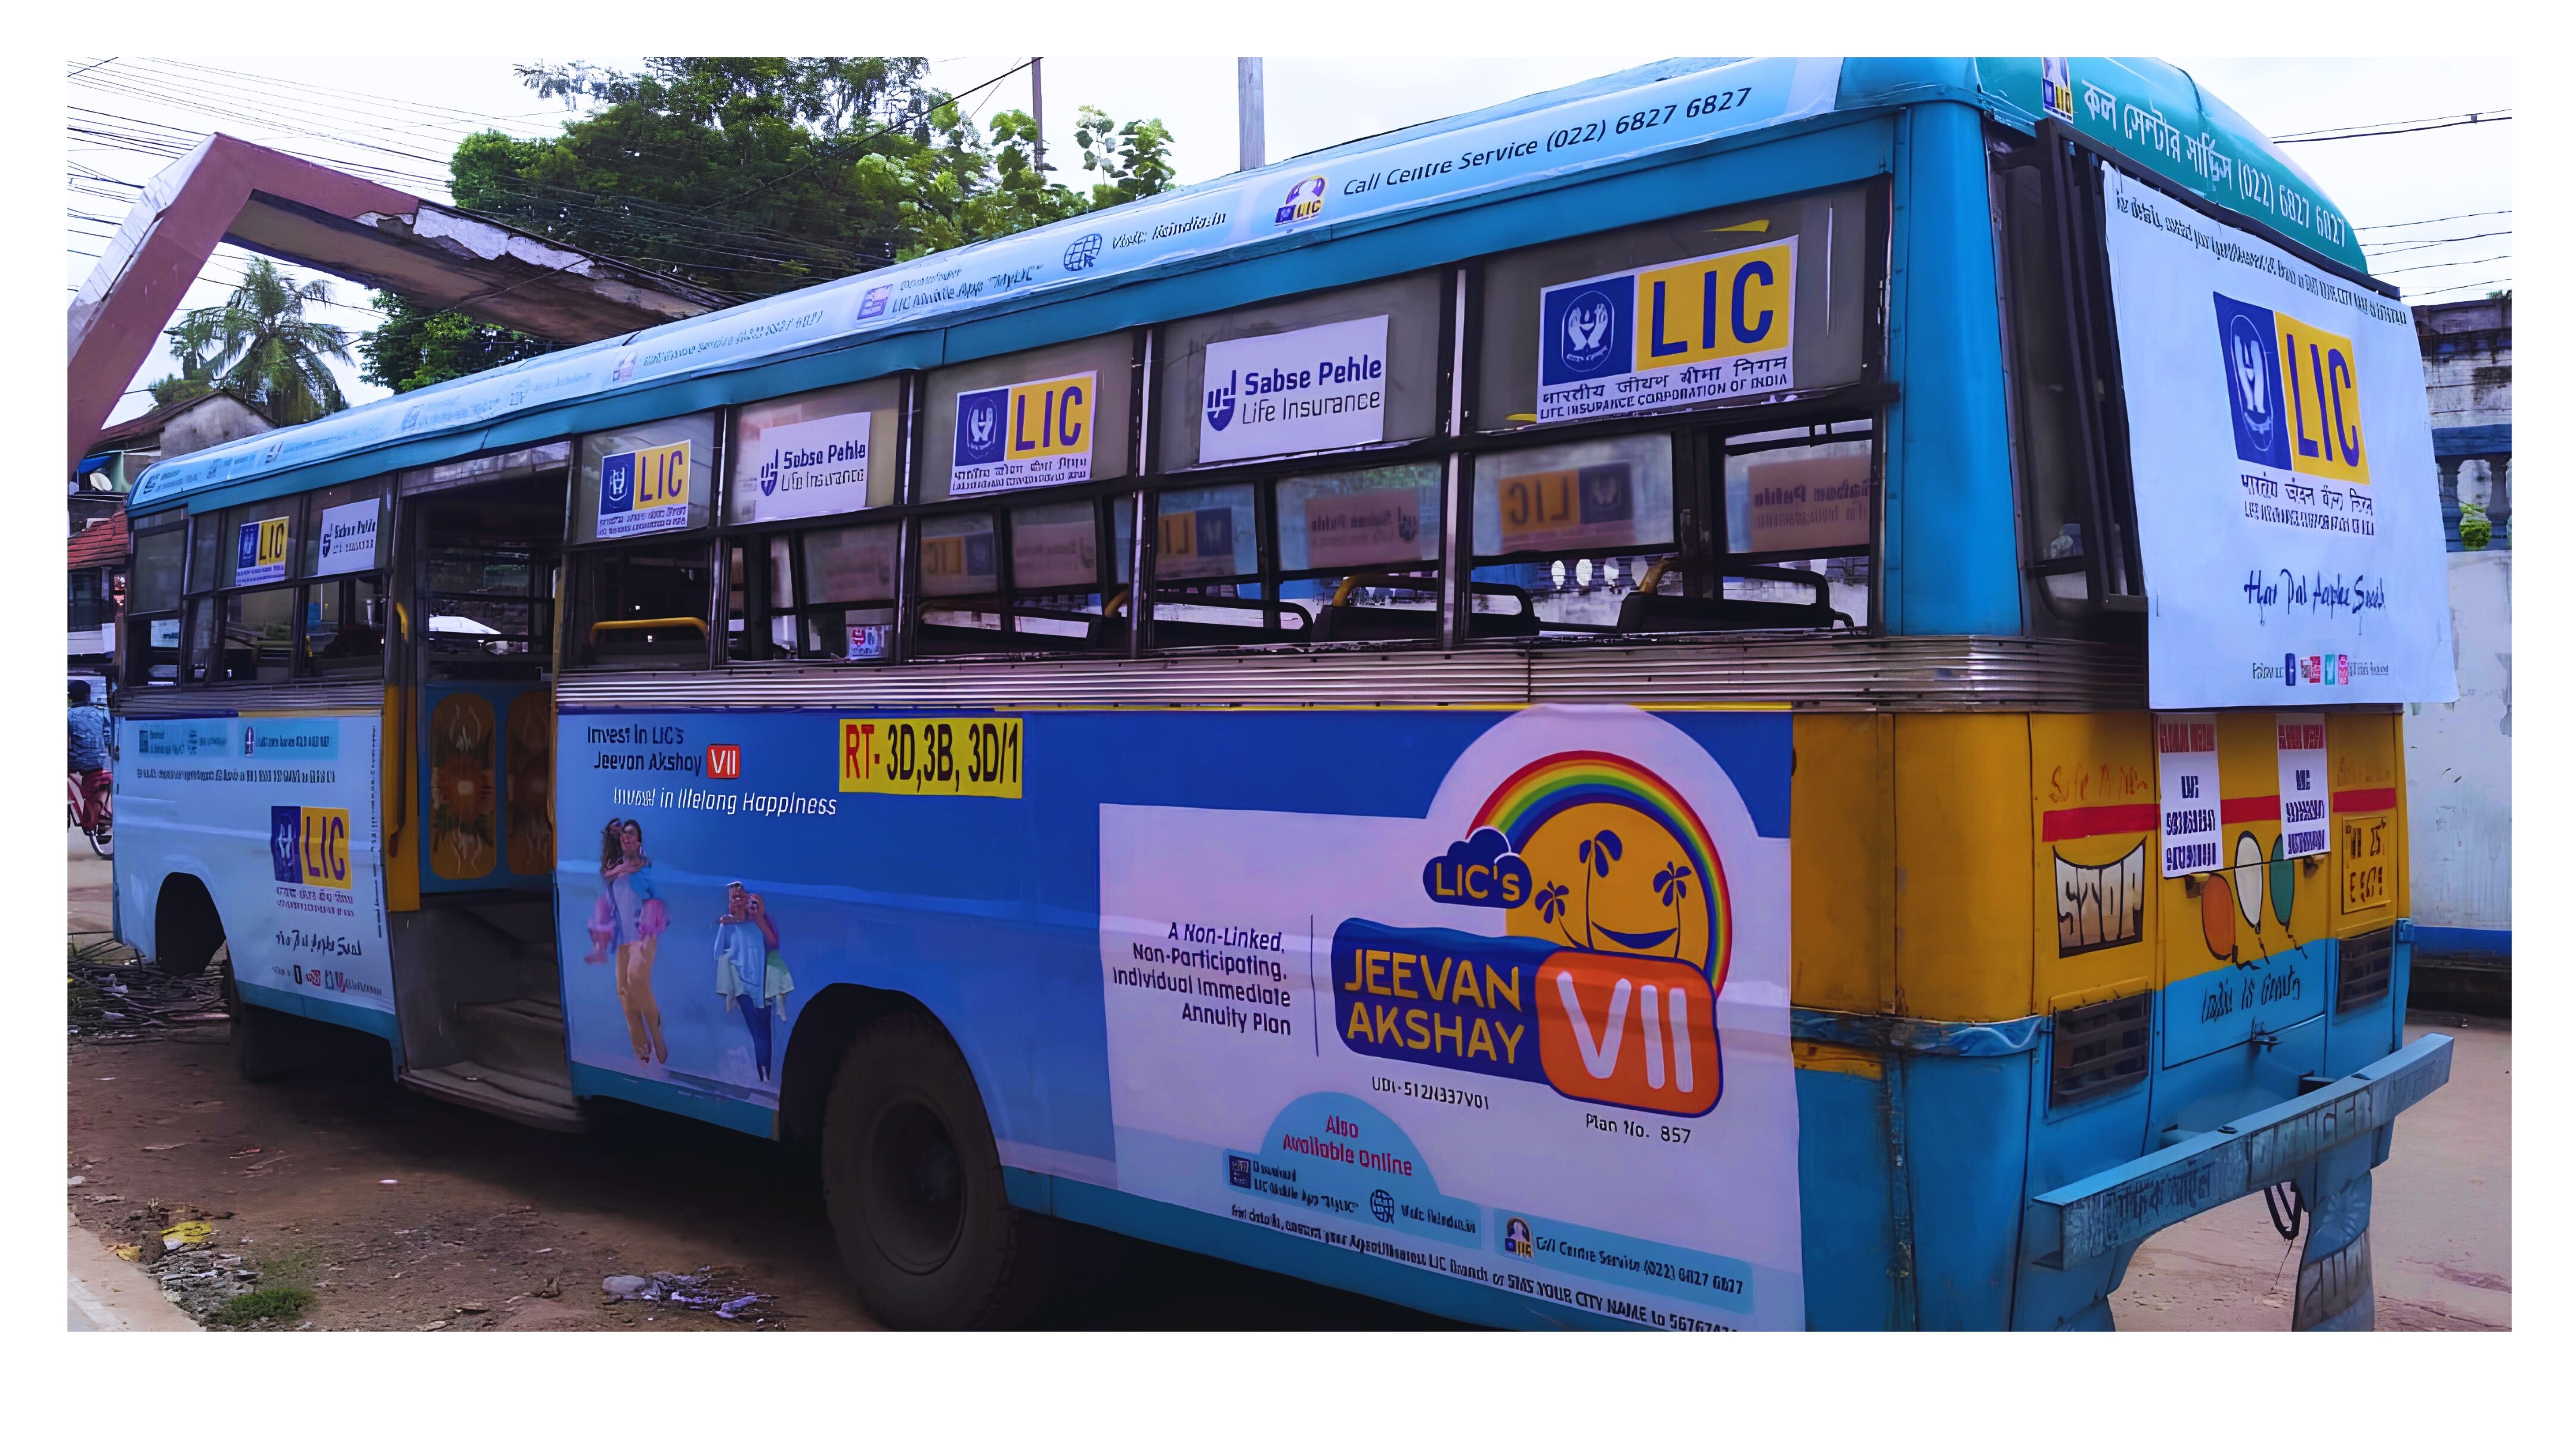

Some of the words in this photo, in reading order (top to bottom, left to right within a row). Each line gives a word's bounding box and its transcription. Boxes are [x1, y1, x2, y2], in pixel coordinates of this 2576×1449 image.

[2081, 78, 2117, 131] কল
[1343, 172, 1381, 195] Call
[1386, 160, 1453, 185] Centre
[1459, 137, 1538, 170] Service
[1546, 119, 1607, 153] (022)
[1615, 104, 1678, 135] 6827
[1686, 87, 1753, 118] 6827
[2238, 159, 2274, 215] (022)
[2279, 184, 2309, 229] 6827
[1651, 260, 1775, 358] LIC
[1245, 368, 1311, 396] Sabse
[1318, 354, 1382, 386] Pehle
[1015, 385, 1083, 451] LIC
[1242, 398, 1275, 425] Life
[1283, 391, 1380, 421] Insurance
[2286, 333, 2360, 467] LIC
[639, 450, 683, 503] LIC
[258, 522, 284, 561] LIC
[711, 748, 736, 775] VII
[968, 723, 1020, 784] 3D/1
[305, 816, 346, 881] LIC
[1435, 862, 1521, 902] LIC's
[2056, 850, 2144, 948] STOP
[1167, 921, 1179, 940] A
[1184, 923, 1285, 955] Non-Linked,
[1132, 942, 1287, 983] Non-Participating,
[1344, 948, 1524, 1013] JEEVAN
[1113, 966, 1193, 995] Individual
[1197, 977, 1291, 1008] Immediate
[1181, 1002, 1247, 1034] Annuity
[1253, 1013, 1291, 1036] Plan
[1346, 1001, 1526, 1065] AKSHAY
[1556, 970, 1694, 1094] VII
[1325, 1114, 1359, 1139] Also
[1585, 1112, 1618, 1134] Plan
[1660, 1125, 1692, 1144] 857
[1282, 1133, 1355, 1165] Available
[1359, 1149, 1413, 1176] Online
[1575, 1291, 1604, 1312] CITY
[1606, 1298, 1648, 1323] NAME
